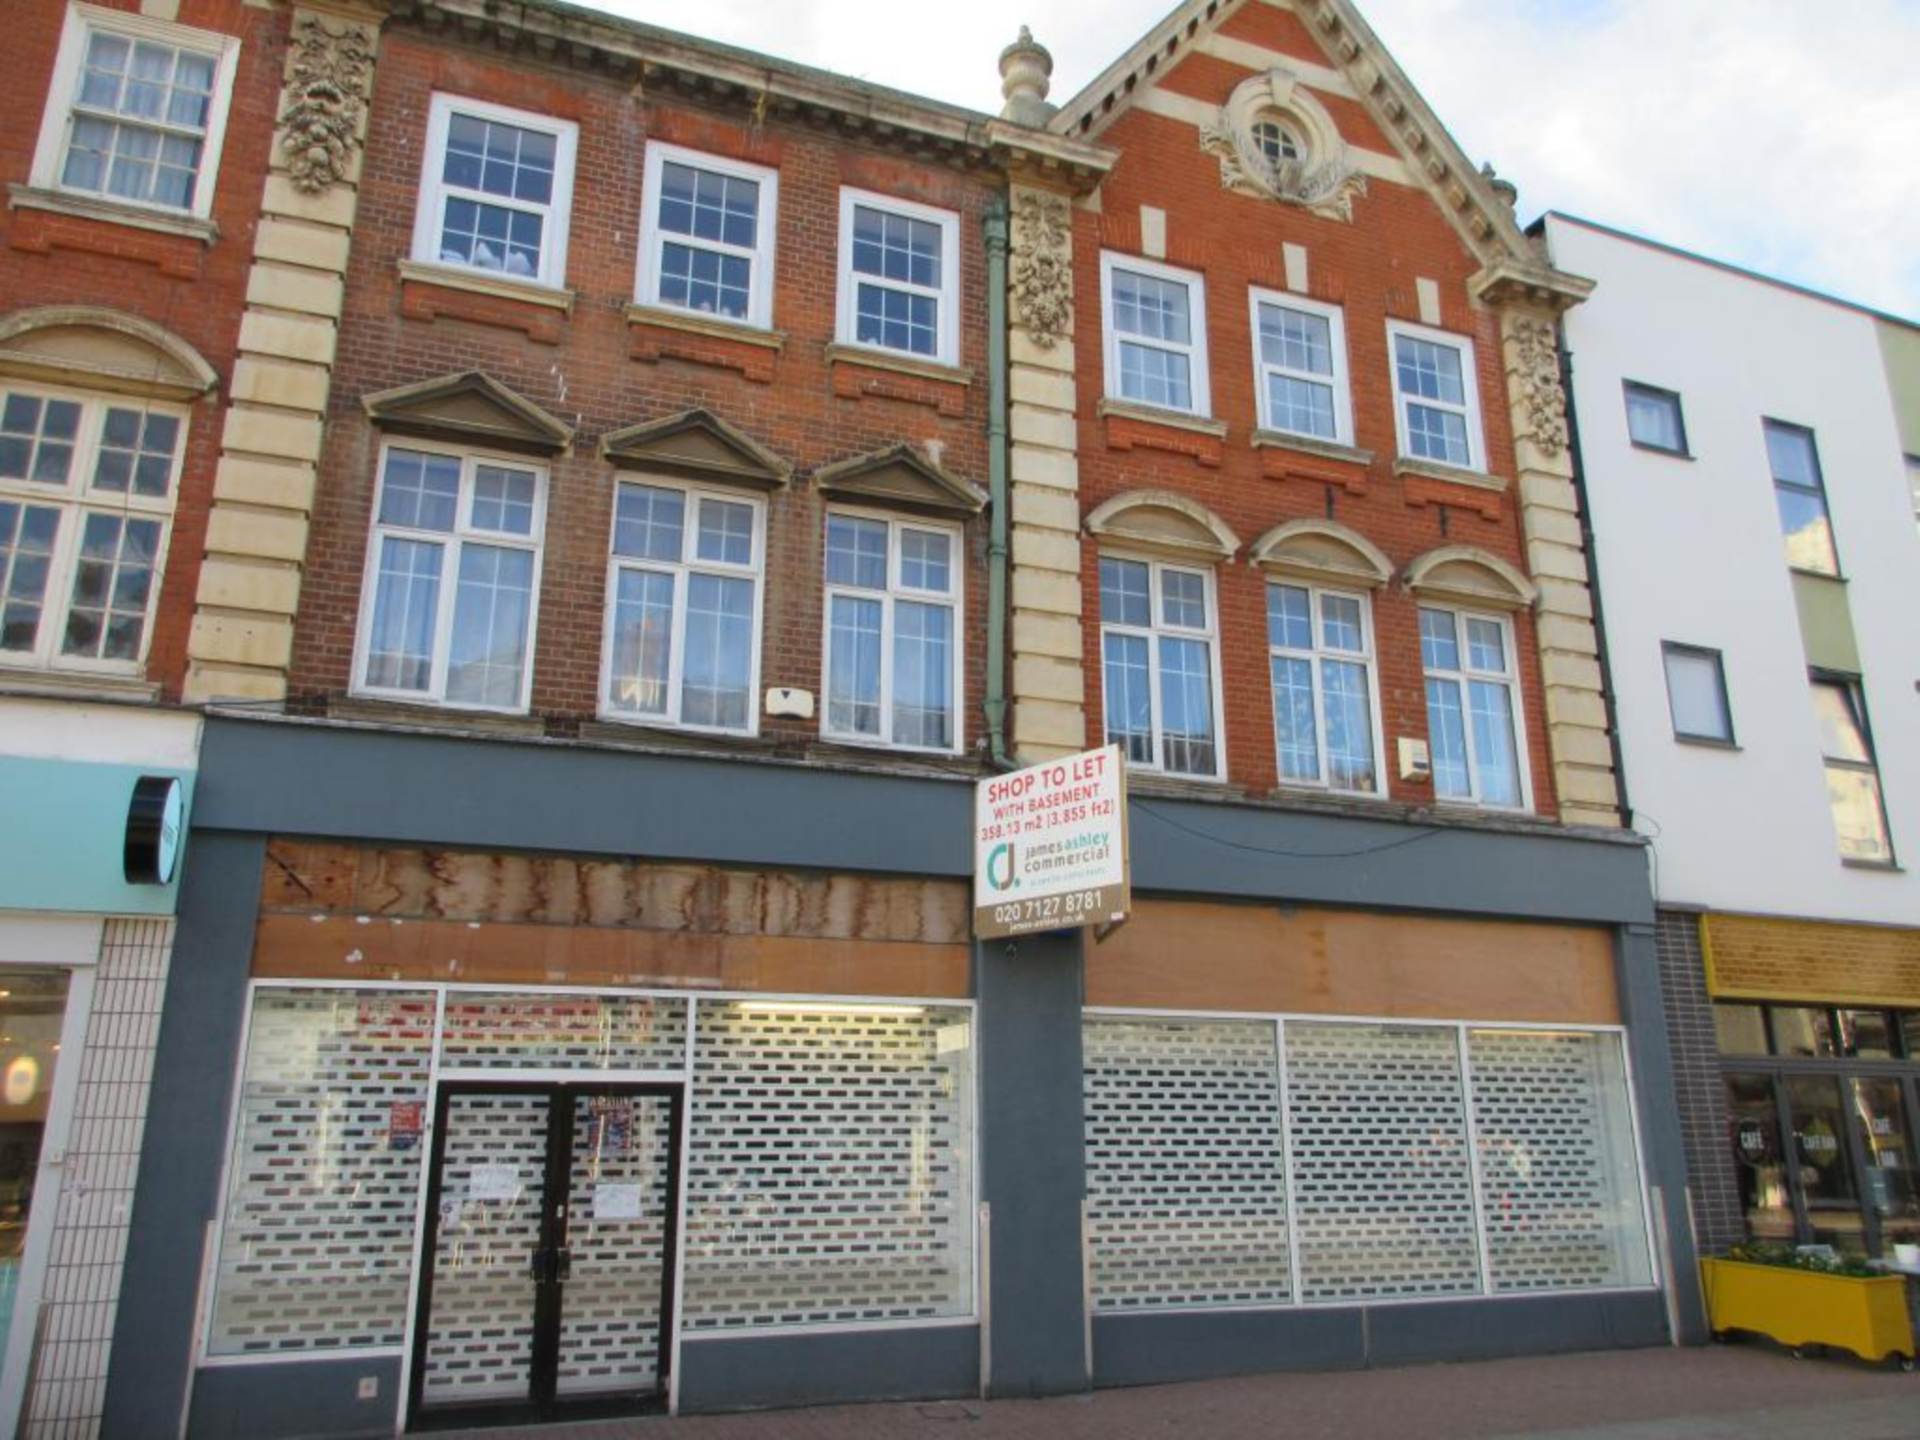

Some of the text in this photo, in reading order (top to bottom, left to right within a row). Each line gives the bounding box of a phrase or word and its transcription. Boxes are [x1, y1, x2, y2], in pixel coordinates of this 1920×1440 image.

[988, 755, 1106, 803] SHOP TO LET
[993, 783, 1099, 820] WITH BASEMENT
[1024, 816, 1042, 832] m2
[1025, 845, 1109, 873] commercial
[994, 889, 1101, 923] 020 7127 8781
